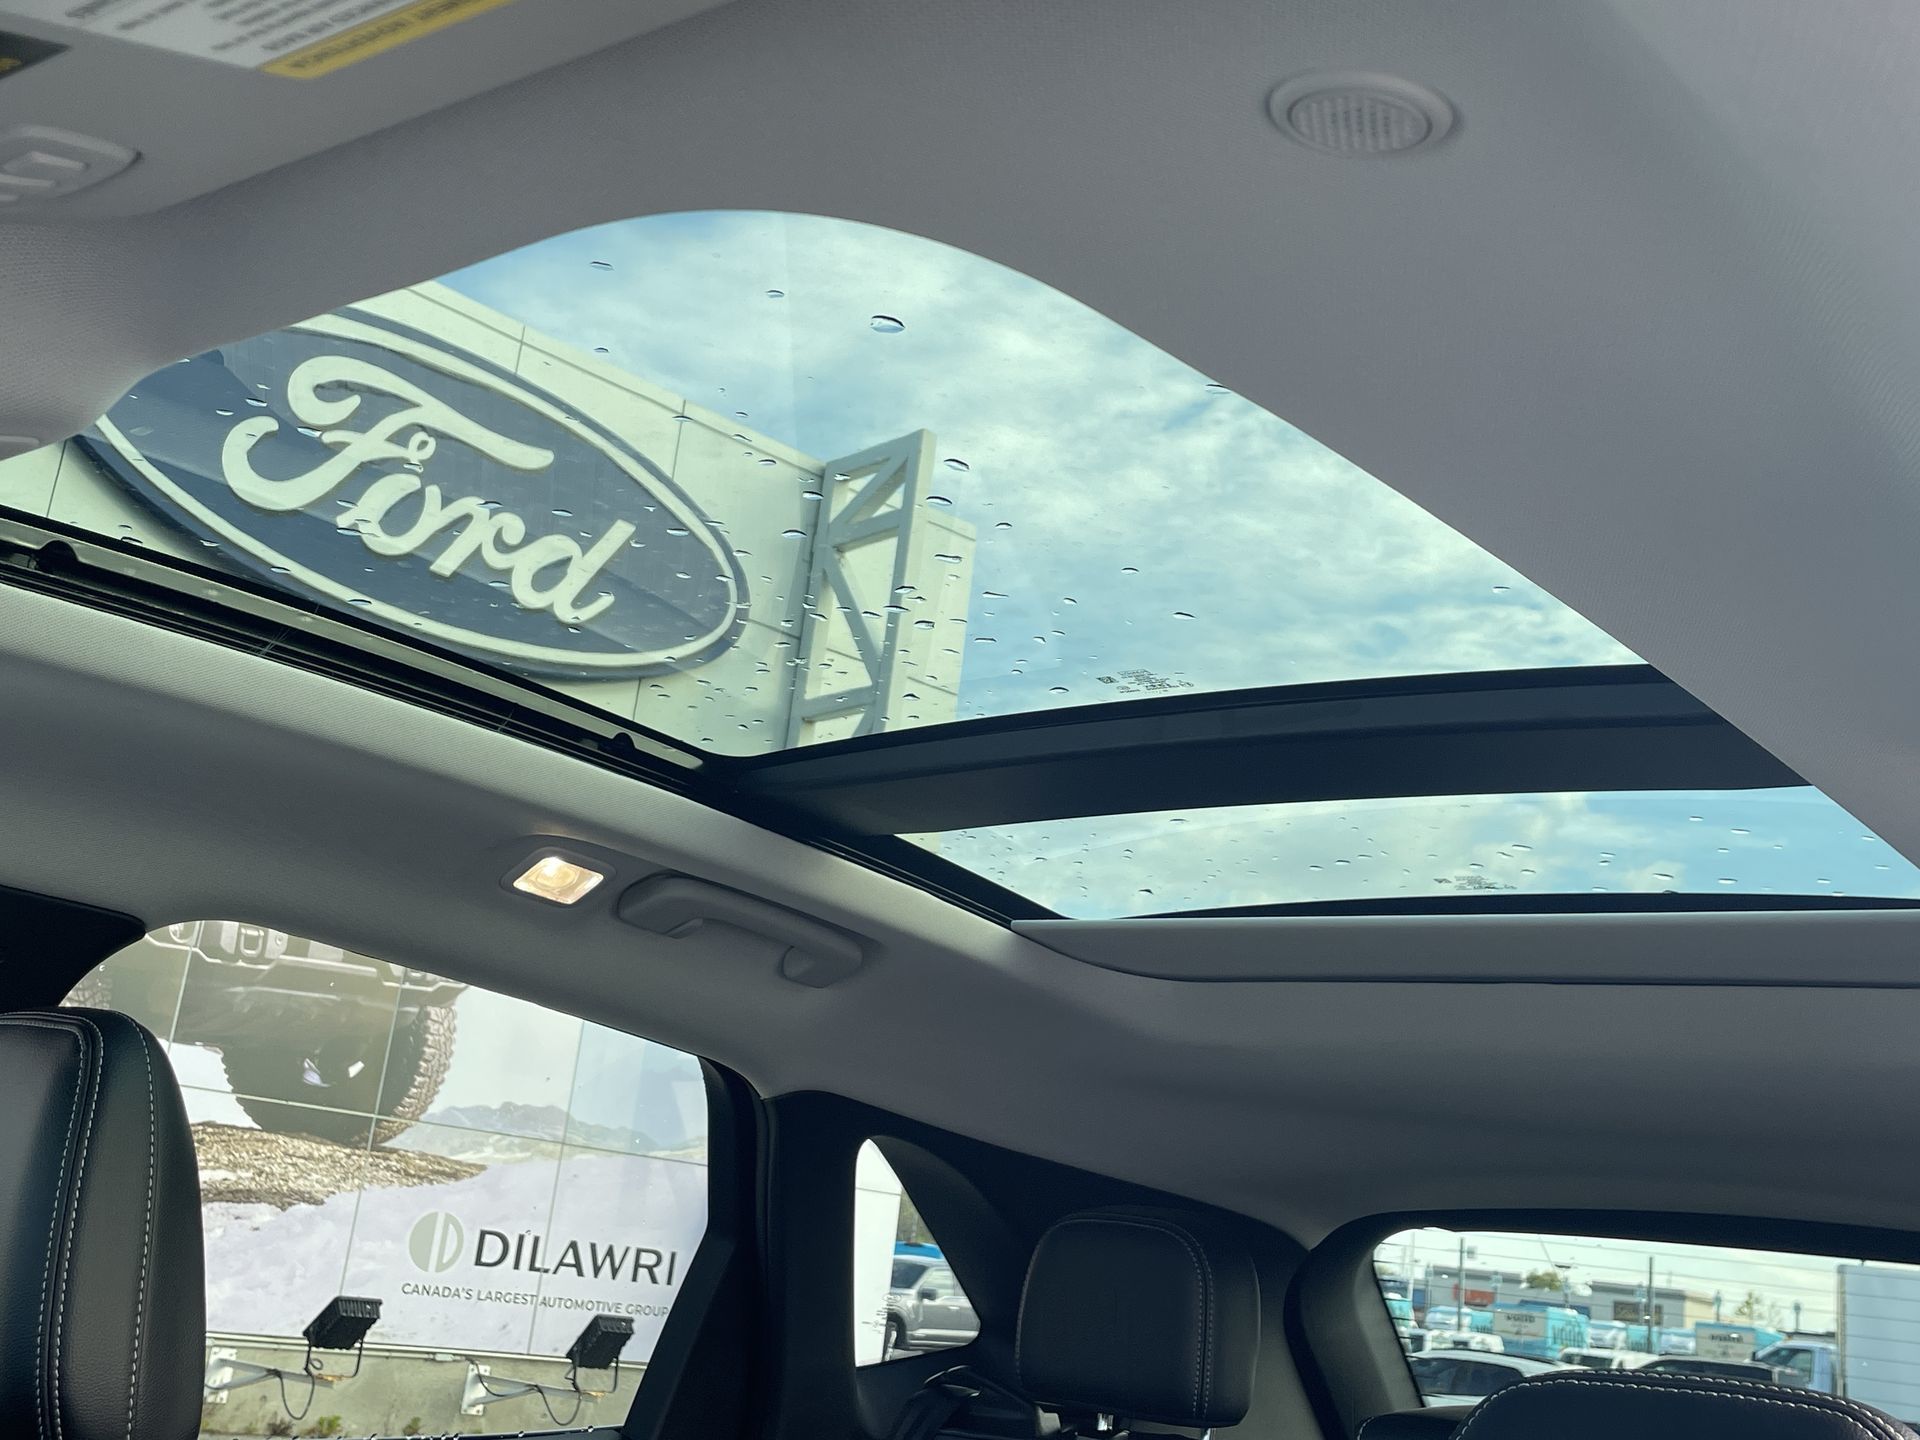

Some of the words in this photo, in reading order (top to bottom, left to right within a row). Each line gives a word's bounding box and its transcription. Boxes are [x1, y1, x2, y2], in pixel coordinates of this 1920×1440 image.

[222, 355, 637, 624] Ford
[474, 1229, 677, 1286] DILAWRI
[401, 1283, 473, 1300] CANADA'S
[477, 1290, 537, 1305] LARGEST
[539, 1296, 622, 1314] AUTOMOTIVE
[625, 1303, 670, 1318] GROUP
